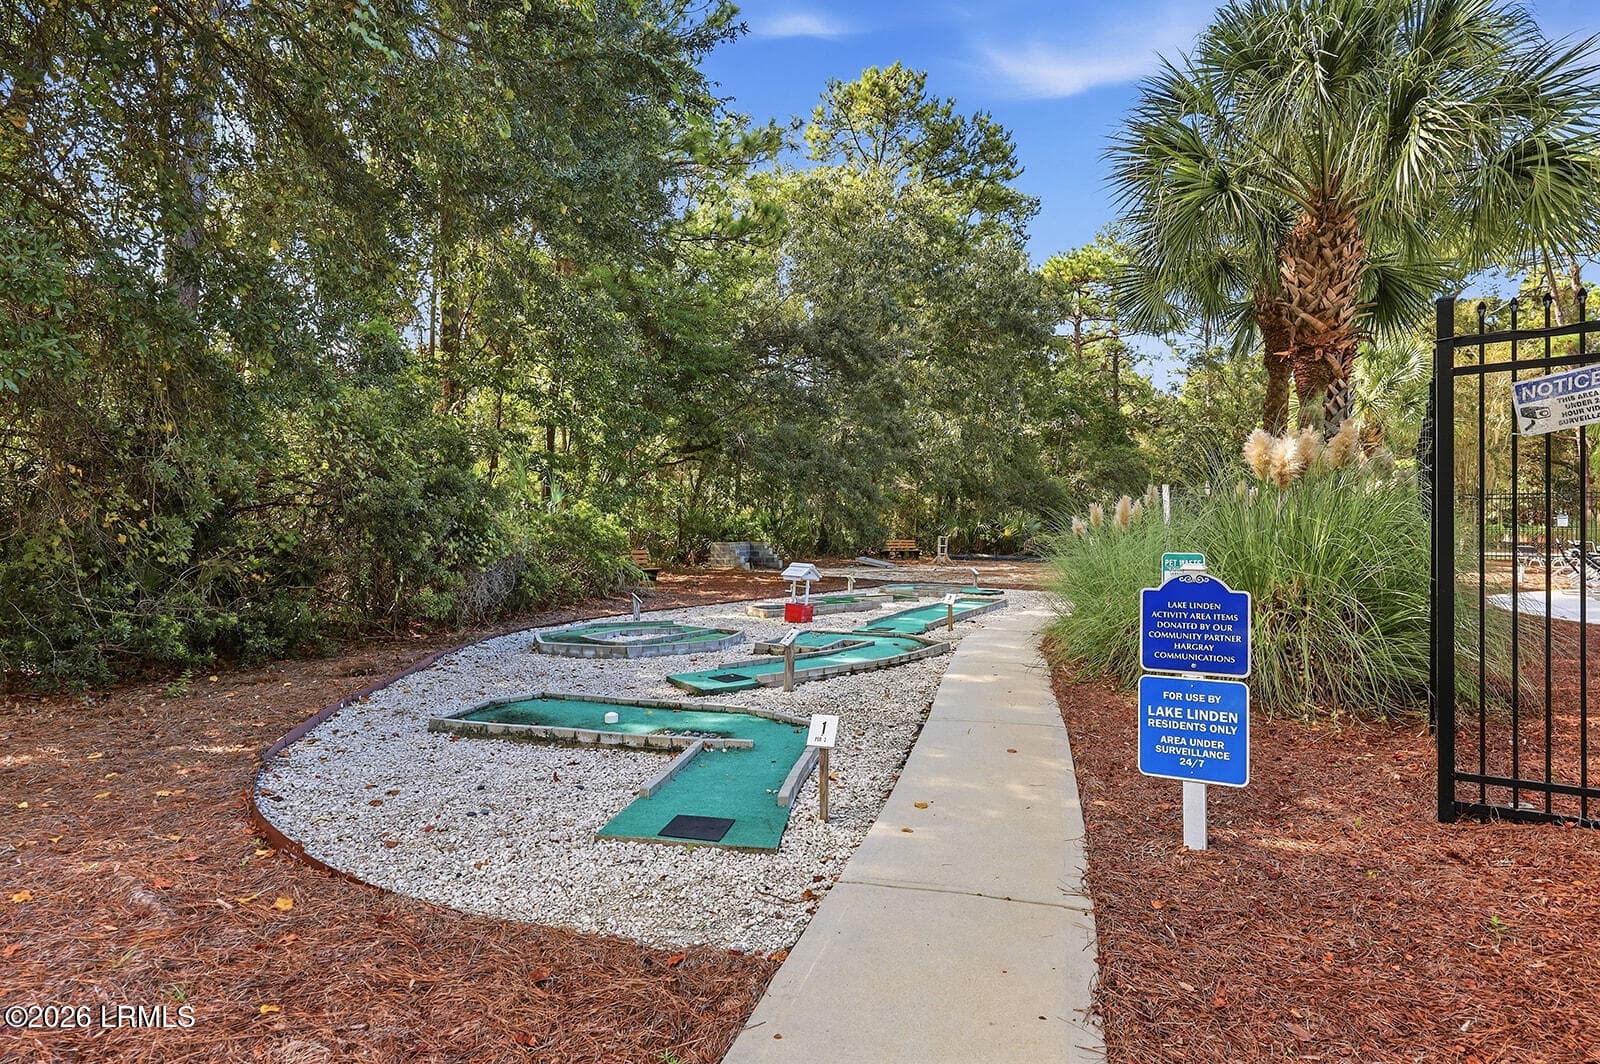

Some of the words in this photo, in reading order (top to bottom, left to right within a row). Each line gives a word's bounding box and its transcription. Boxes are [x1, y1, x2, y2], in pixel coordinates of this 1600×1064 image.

[1522, 371, 1600, 400] NOTICE
[1556, 394, 1576, 403] THIS
[1578, 390, 1599, 400] AREA
[1565, 399, 1592, 409] UNDER
[1562, 408, 1584, 418] HOUR
[1190, 602, 1221, 610] LINDEN
[1152, 611, 1188, 619] ACTIVITY
[1157, 621, 1198, 630] DONATED
[1148, 631, 1202, 640] COMMUNITY
[1204, 633, 1242, 642] PARTNER
[1174, 642, 1214, 651] HARGRAY
[1154, 651, 1236, 663] COMMUNICATIONS
[1163, 691, 1182, 701] FOR
[1186, 693, 1206, 702] USE
[1208, 695, 1221, 704] BY
[1148, 705, 1183, 718] LAKE
[1187, 708, 1238, 724] LINDEN
[822, 721, 827, 736] 1
[1148, 718, 1206, 732] RESIDENTS
[1210, 724, 1238, 735] ONLY
[1160, 736, 1187, 746] AREA
[1190, 738, 1224, 749] UNDER
[1155, 745, 1230, 760] SURVEILLANCE
[1180, 758, 1205, 768] 24/7
